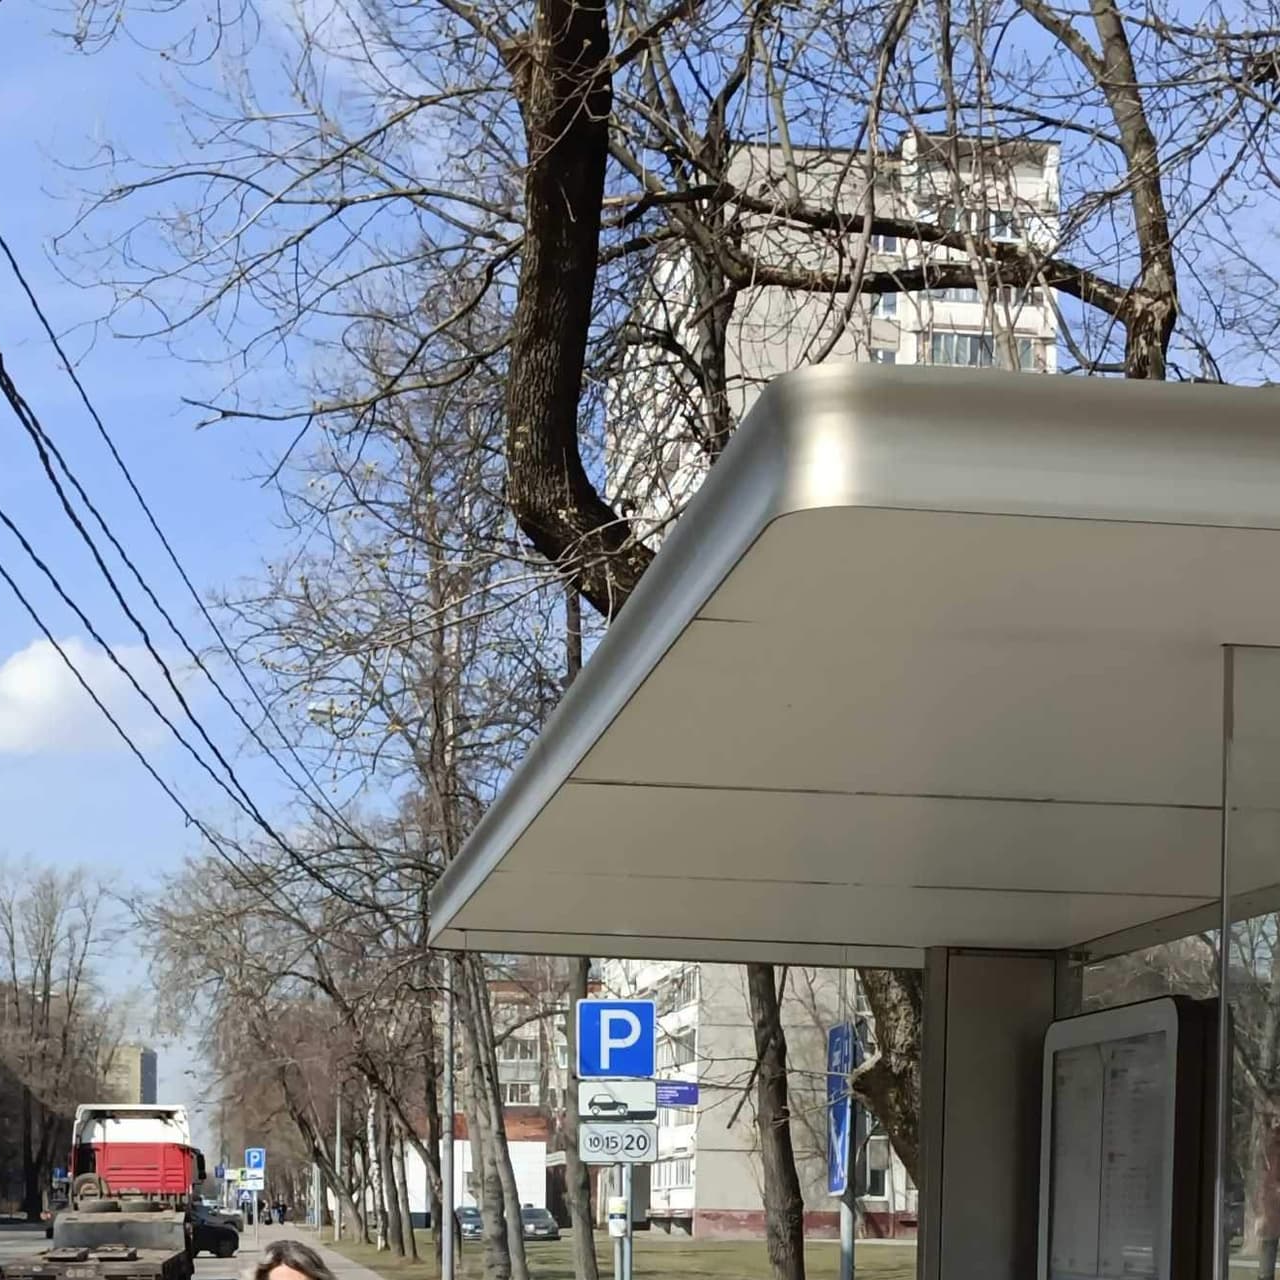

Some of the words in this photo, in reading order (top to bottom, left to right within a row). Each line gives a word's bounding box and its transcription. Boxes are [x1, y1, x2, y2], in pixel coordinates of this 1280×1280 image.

[600, 1008, 642, 1070] P
[588, 1136, 601, 1148] 10
[605, 1136, 619, 1149] 15
[624, 1134, 648, 1151] 20
[250, 1151, 260, 1168] P
